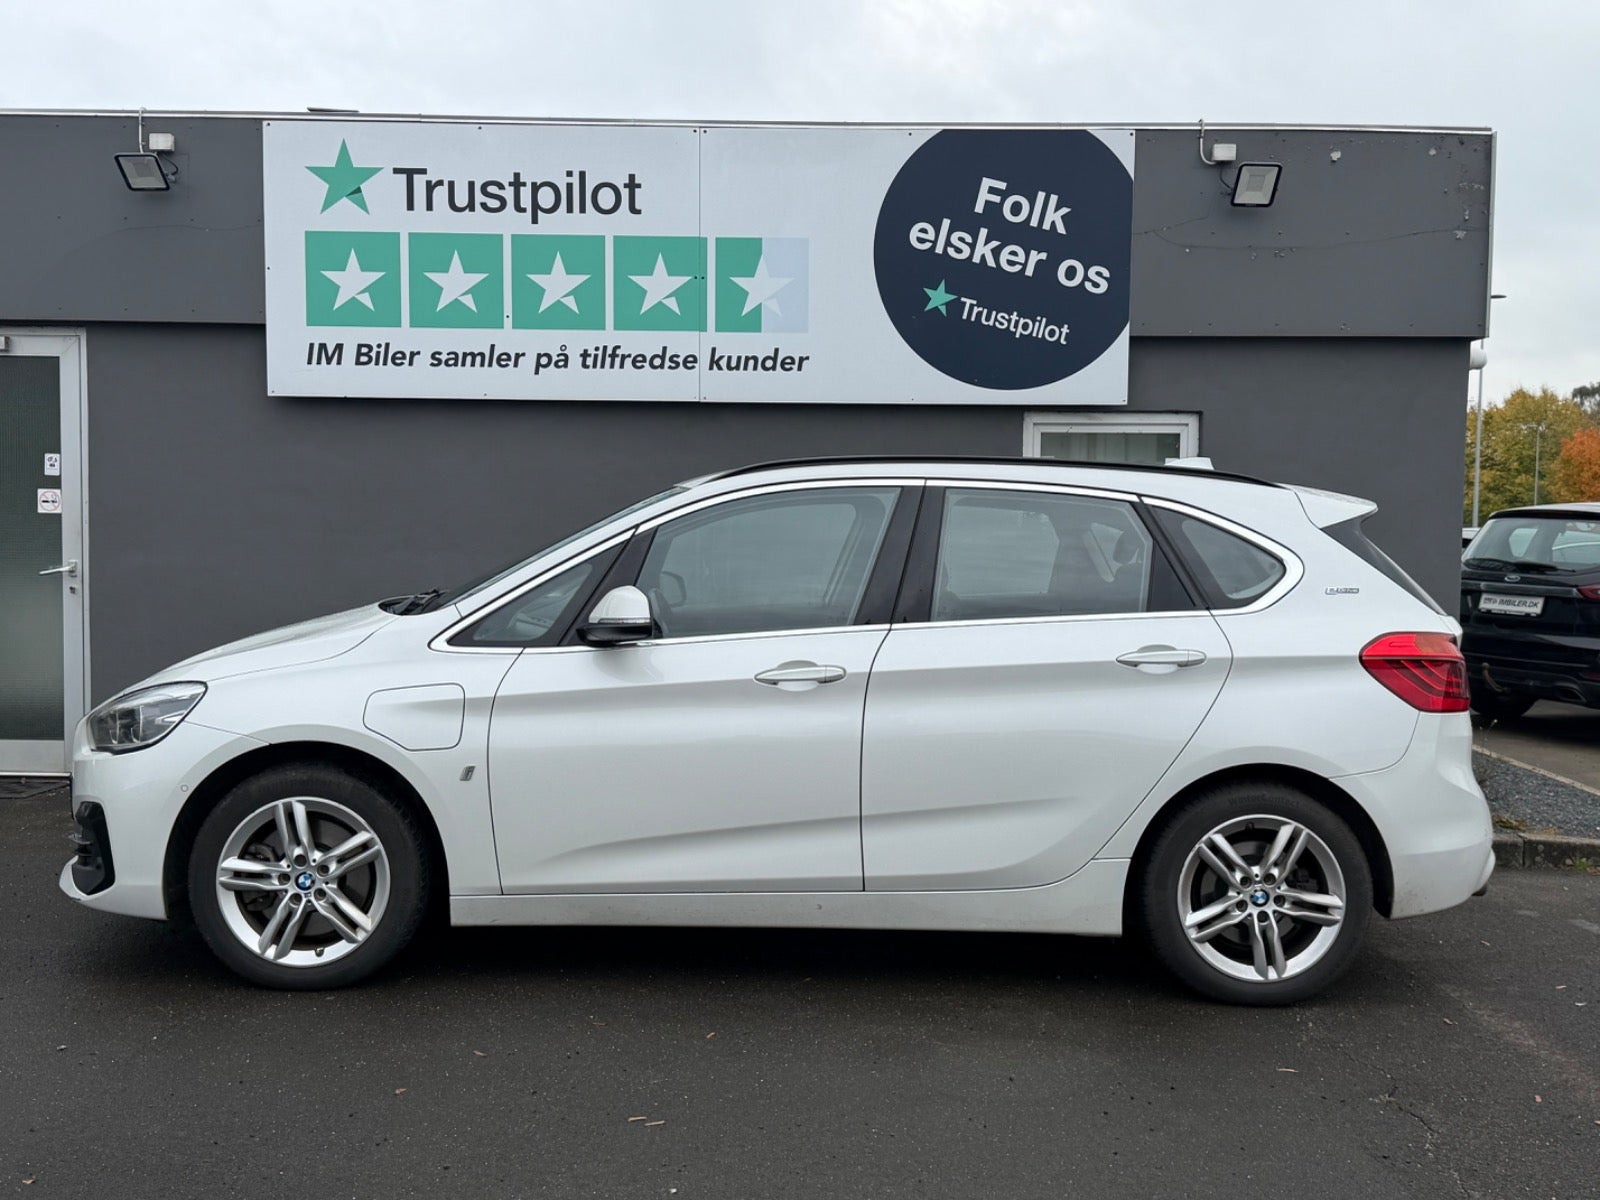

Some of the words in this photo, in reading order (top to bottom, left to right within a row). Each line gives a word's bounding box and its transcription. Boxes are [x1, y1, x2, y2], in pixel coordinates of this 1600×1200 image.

[392, 167, 642, 225] Trustpilot
[973, 176, 1072, 235] Folk
[908, 217, 1048, 277] elsker
[1056, 258, 1111, 294] os
[960, 296, 1070, 345] Trustpilot
[306, 342, 345, 366] IM
[354, 342, 421, 367] Biler
[429, 344, 526, 369] samler
[533, 344, 570, 376] på
[579, 345, 698, 371] tilfredse
[708, 346, 811, 372] kunder
